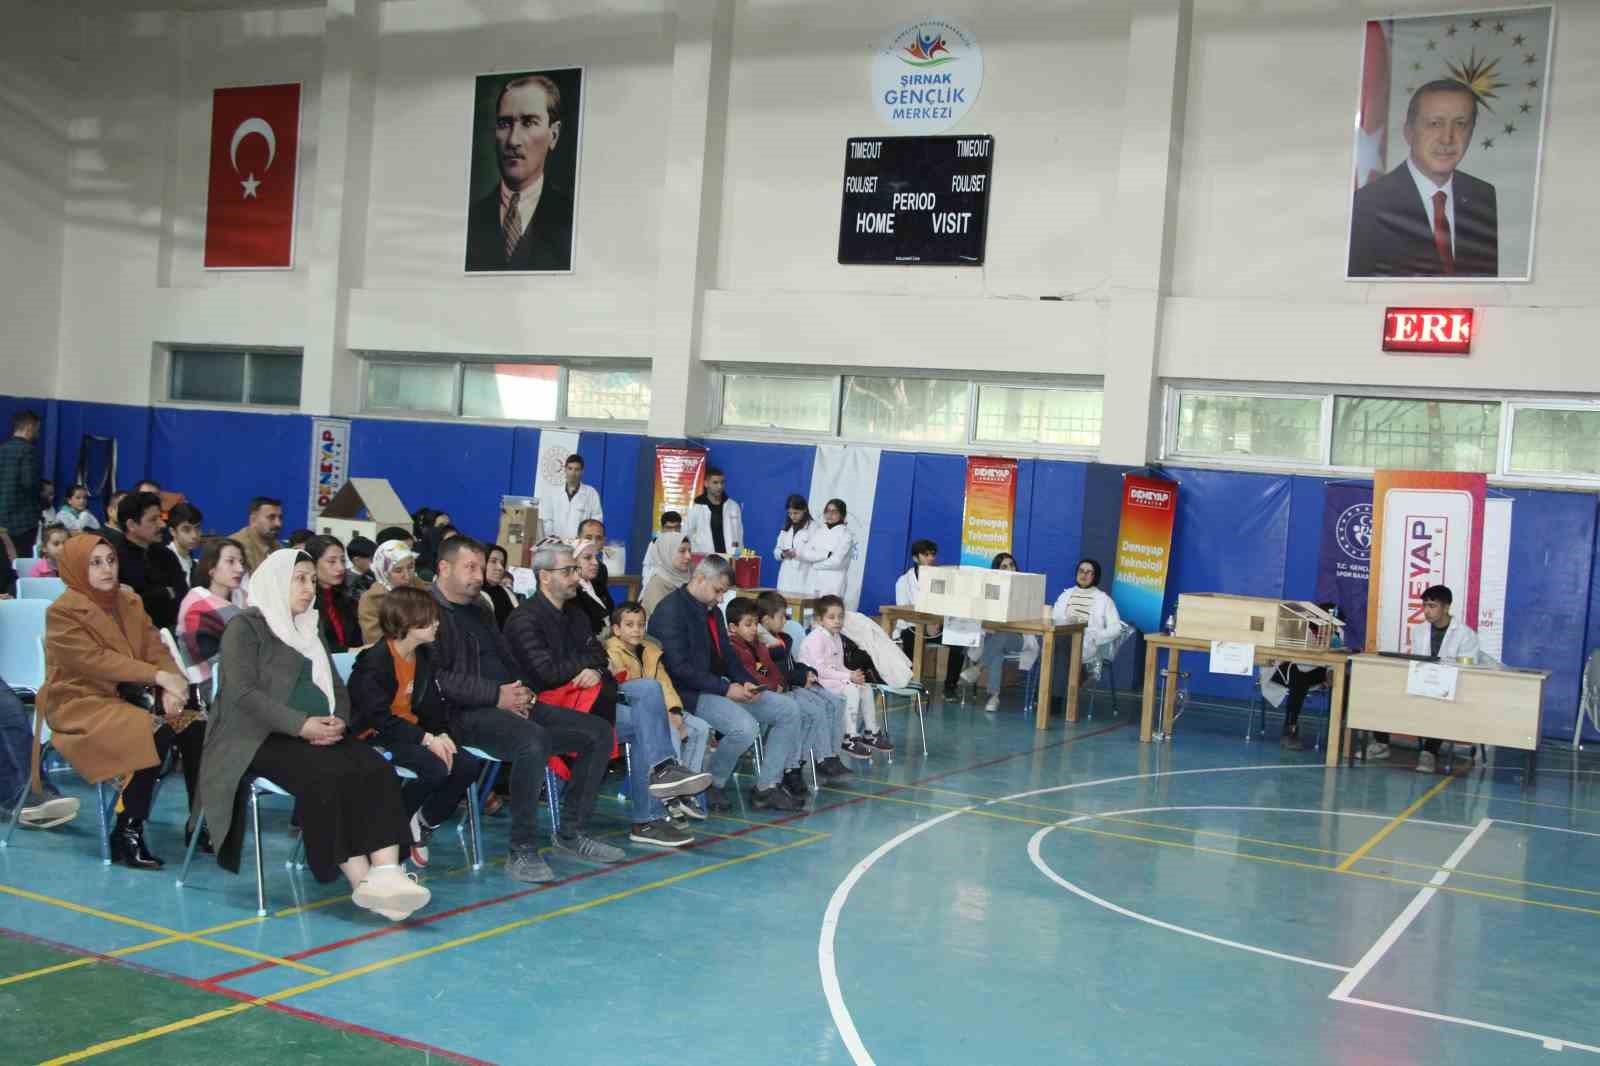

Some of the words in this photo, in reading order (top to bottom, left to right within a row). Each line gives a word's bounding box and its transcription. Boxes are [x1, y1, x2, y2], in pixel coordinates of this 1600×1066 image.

[900, 73, 952, 87] ŞIRNAK
[884, 87, 965, 105] GENÇLİK
[892, 106, 952, 119] MERKEZİ
[850, 142, 883, 159] TIMEOUT
[956, 139, 990, 158] TIMEOUT
[892, 192, 936, 211] PERIOD
[856, 212, 896, 234] HOME
[931, 212, 972, 234] VISIT
[318, 430, 335, 507] DENEYAP
[1121, 540, 1164, 558] Deneyap
[1407, 520, 1433, 655] NEYAP
